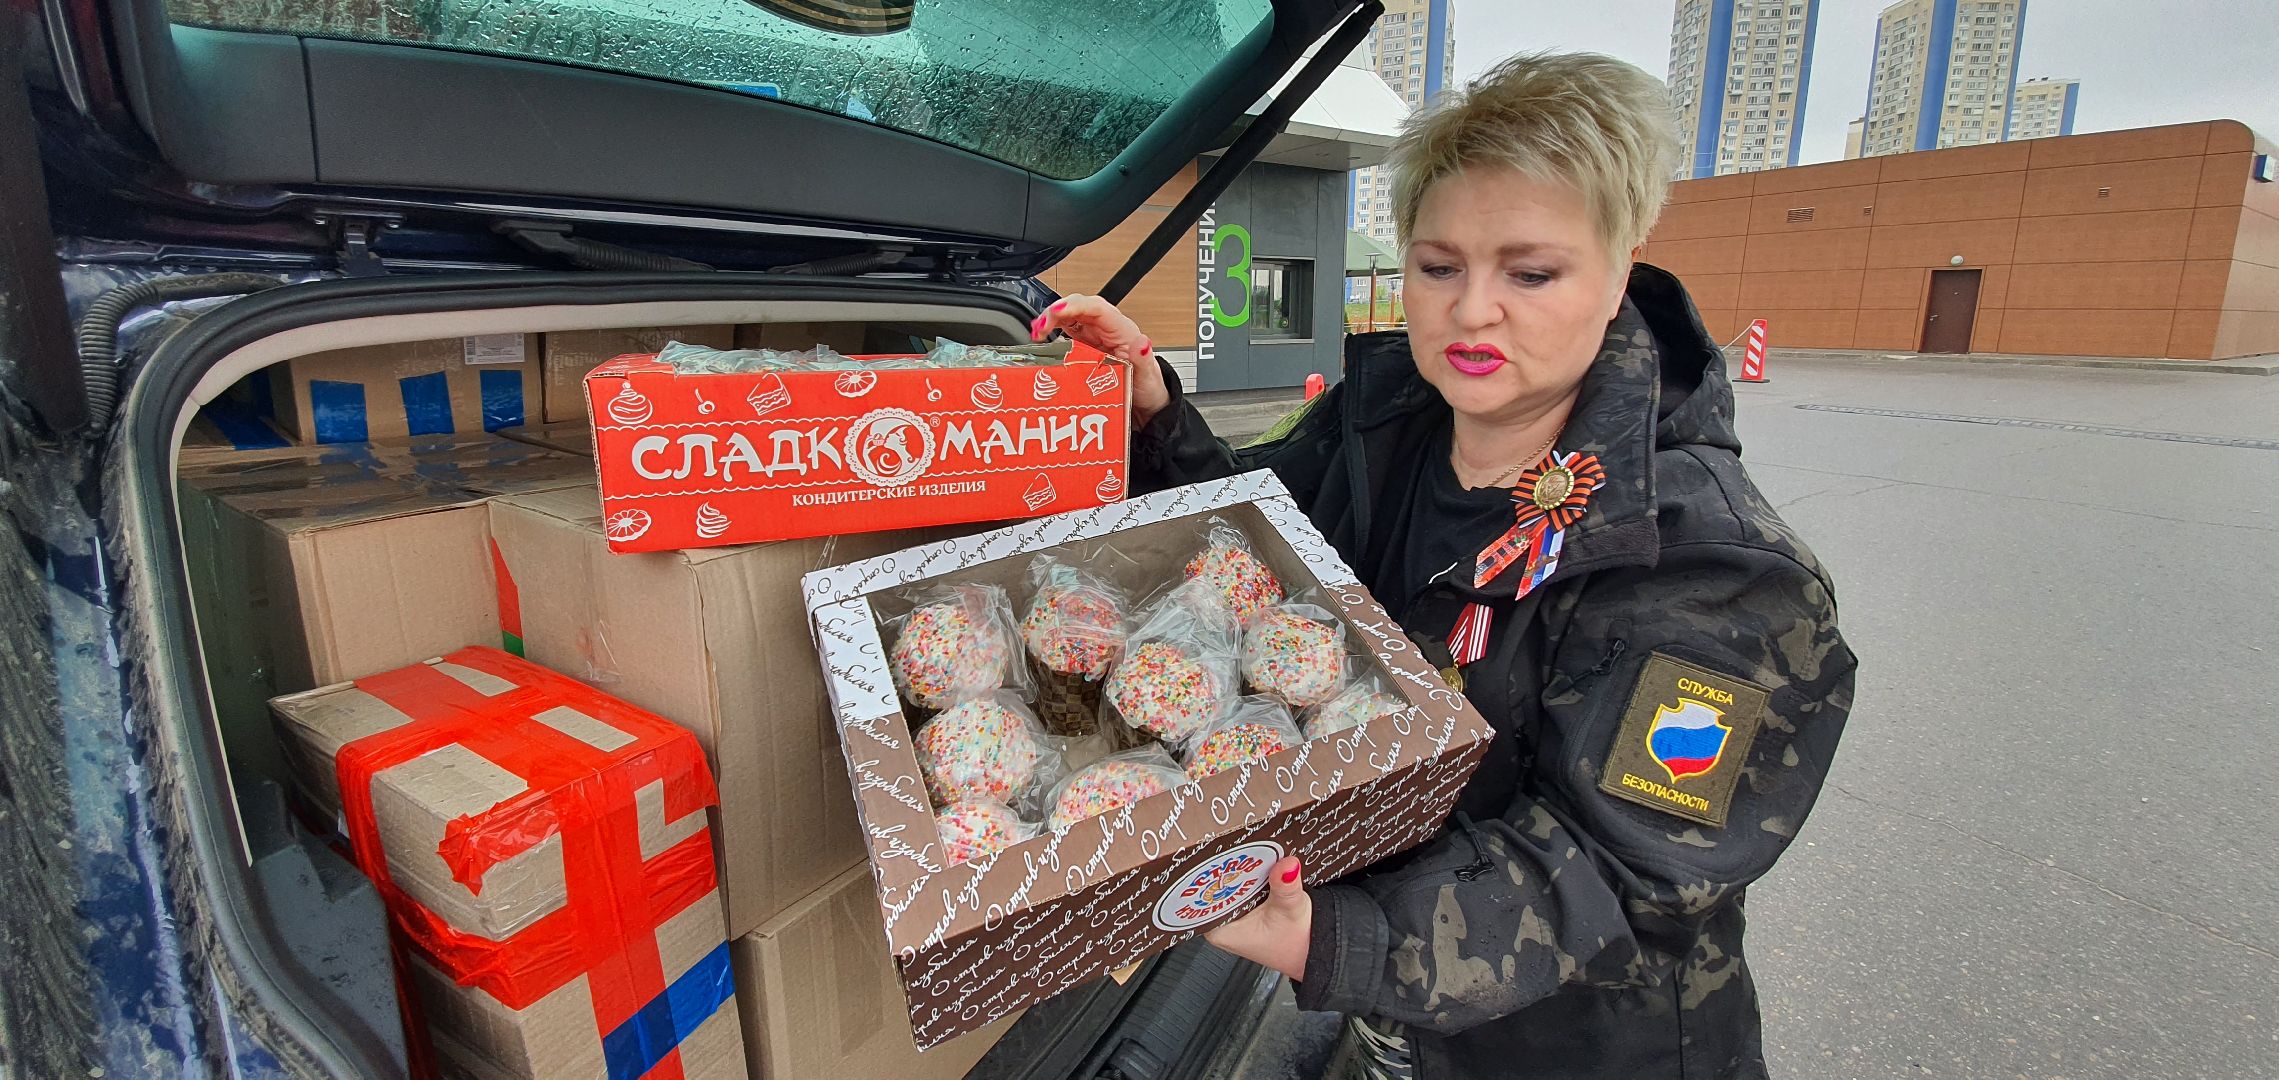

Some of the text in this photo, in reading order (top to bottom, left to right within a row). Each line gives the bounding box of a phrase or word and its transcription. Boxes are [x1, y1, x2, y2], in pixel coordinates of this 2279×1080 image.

[1198, 202, 1216, 359] ПОЛУЧЕНИ
[1208, 223, 1250, 327] 3
[792, 480, 987, 507] КОНДИТЕРСКИЕ ИЗДЕЛИЯ
[1677, 677, 1733, 706] СЛУЖБА
[1621, 773, 1710, 812] БЕЗОПАСНОСТИ
[961, 972, 1020, 1022] Остров
[1091, 875, 1151, 928] Остров
[1013, 910, 1075, 962] Остров
[931, 944, 995, 997] Остров
[1037, 940, 1094, 988] Остров
